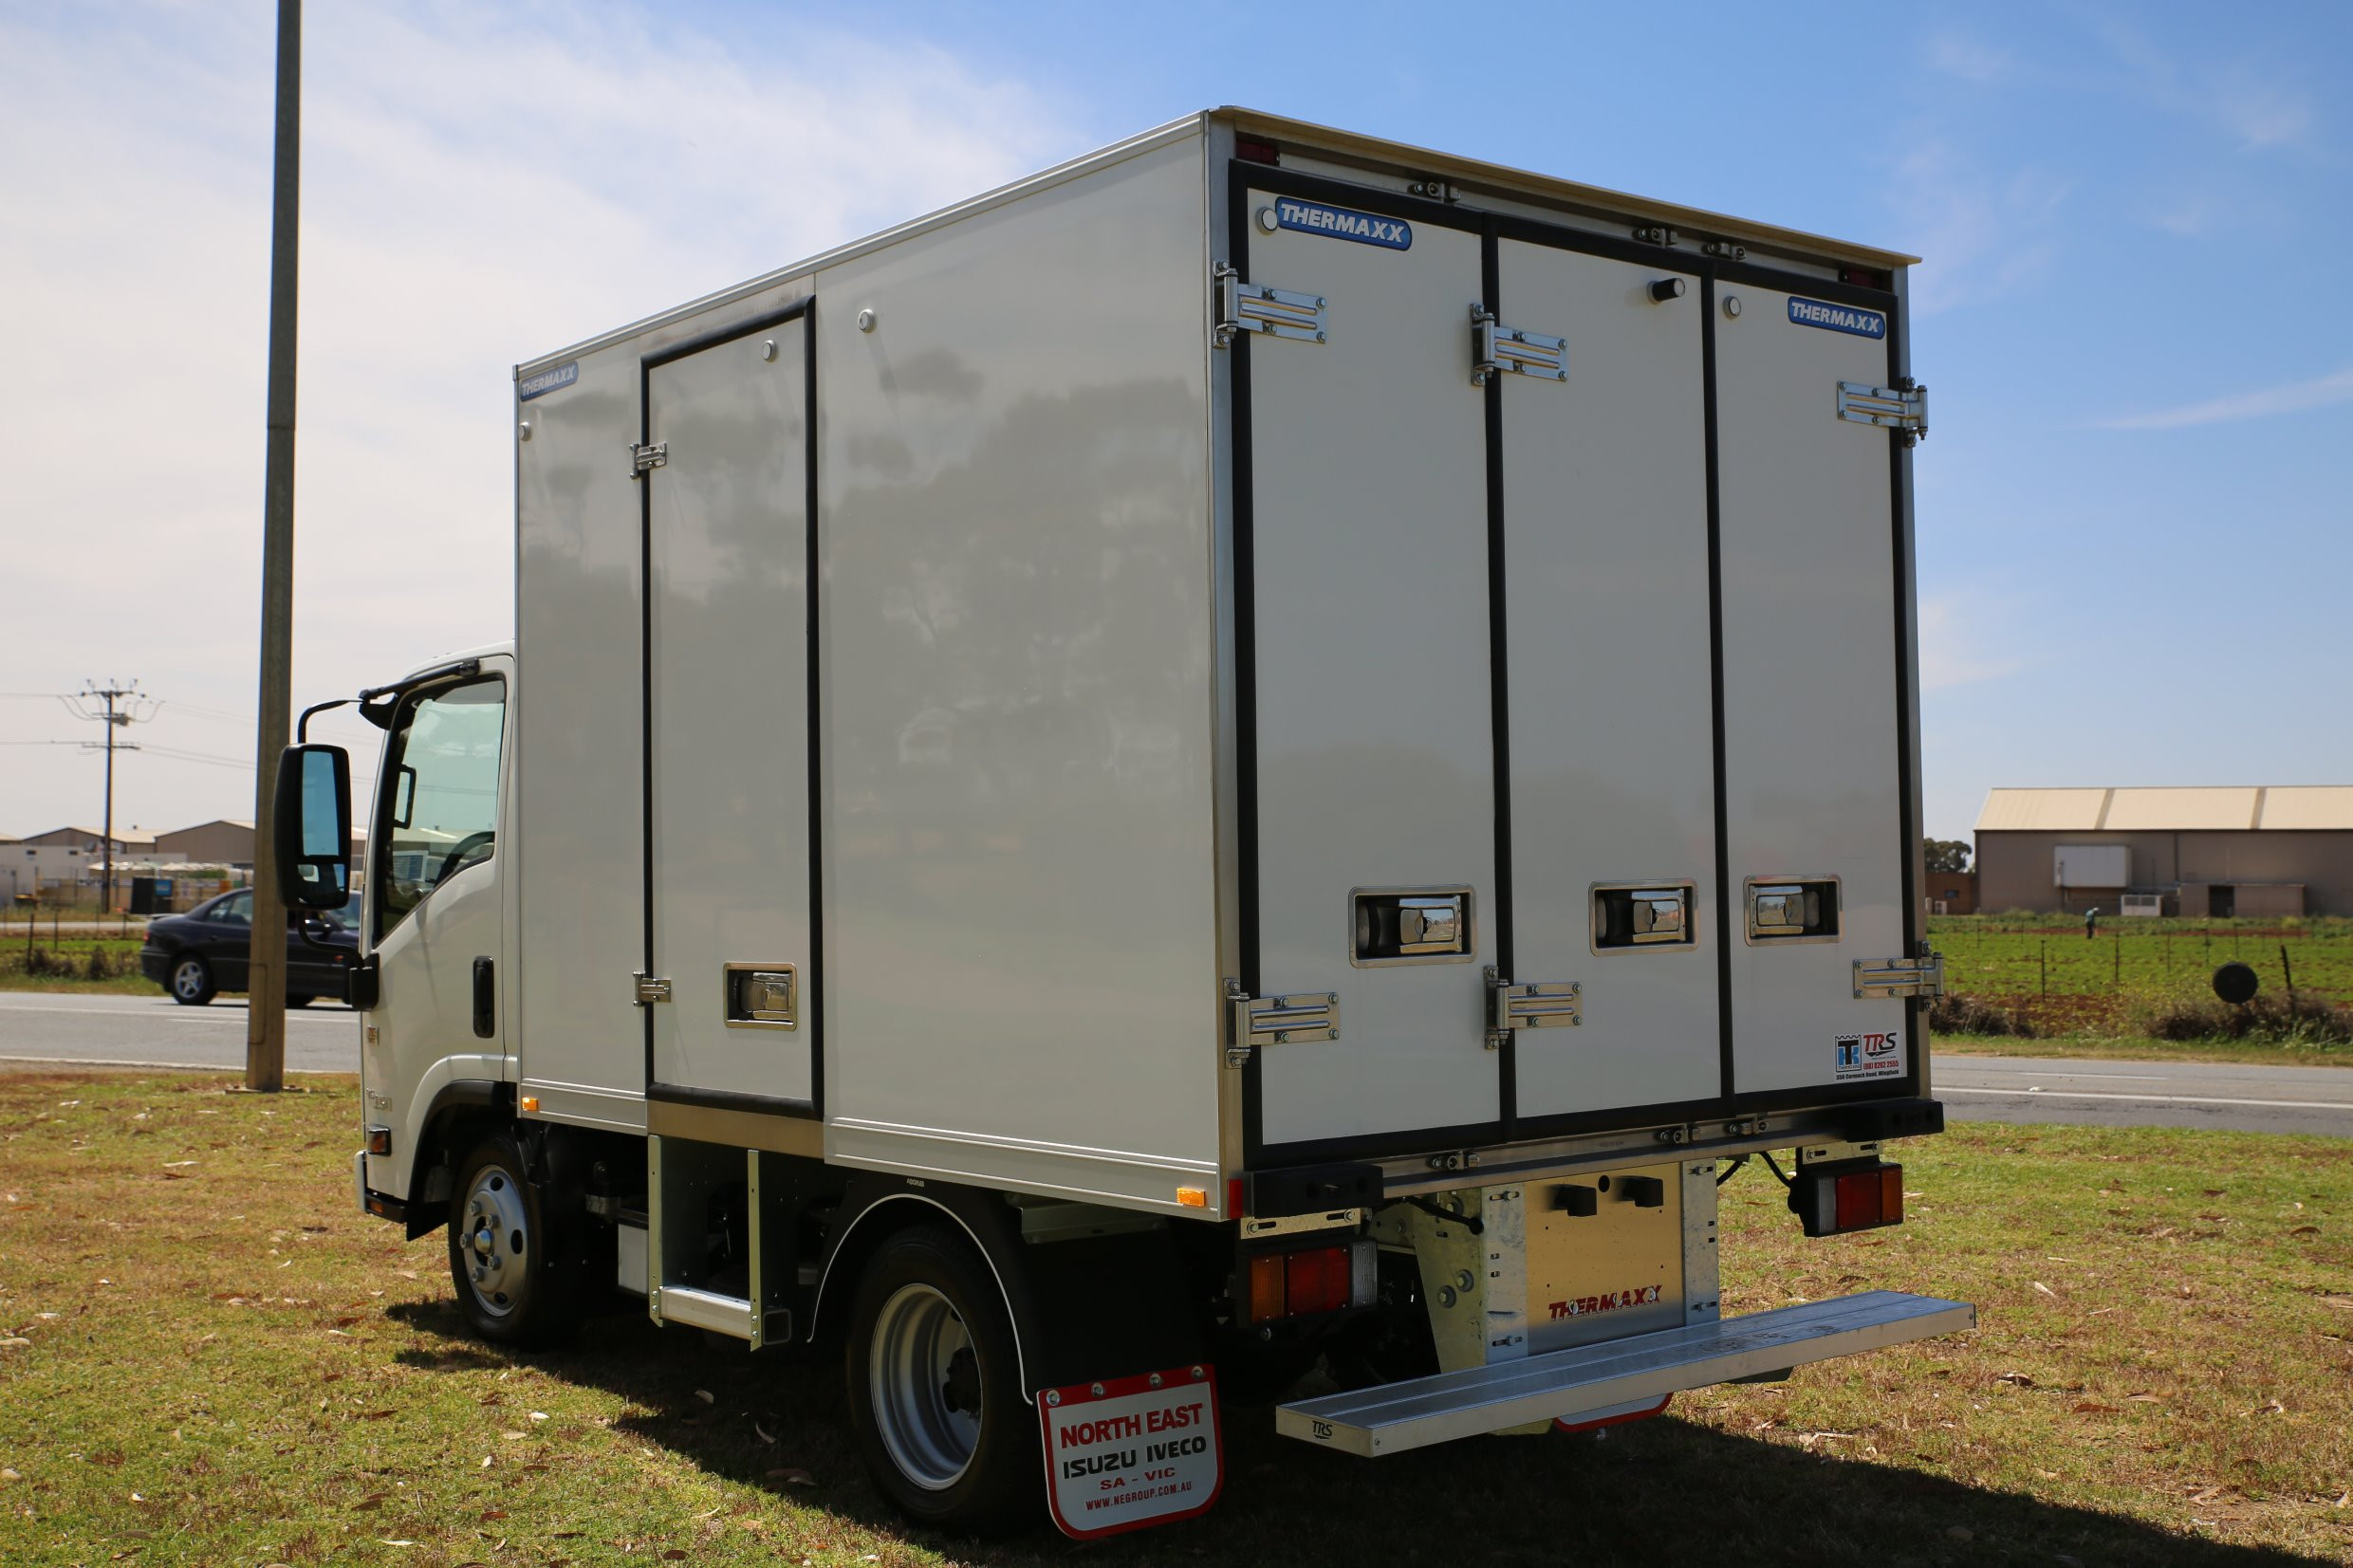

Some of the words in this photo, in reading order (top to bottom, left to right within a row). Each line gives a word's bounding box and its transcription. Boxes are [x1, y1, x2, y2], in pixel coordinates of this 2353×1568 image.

[1281, 203, 1404, 243] THERMAXX
[1791, 302, 1881, 333] THERMAXX
[522, 364, 575, 397] THERMAXX
[1863, 1032, 1897, 1052] TRS
[1887, 1060, 1899, 1068] 2555
[1548, 1284, 1662, 1321] THERMAXX
[1060, 1413, 1141, 1448] NORTH
[1146, 1403, 1203, 1433] EAST
[1312, 1420, 1333, 1437] TRS
[1063, 1449, 1137, 1480] ISUZU
[1146, 1435, 1207, 1463] IVECO
[1100, 1477, 1126, 1490] SA
[1144, 1467, 1176, 1482] VIC
[1085, 1481, 1193, 1511] WWW.NEGROUP.COM.AU
